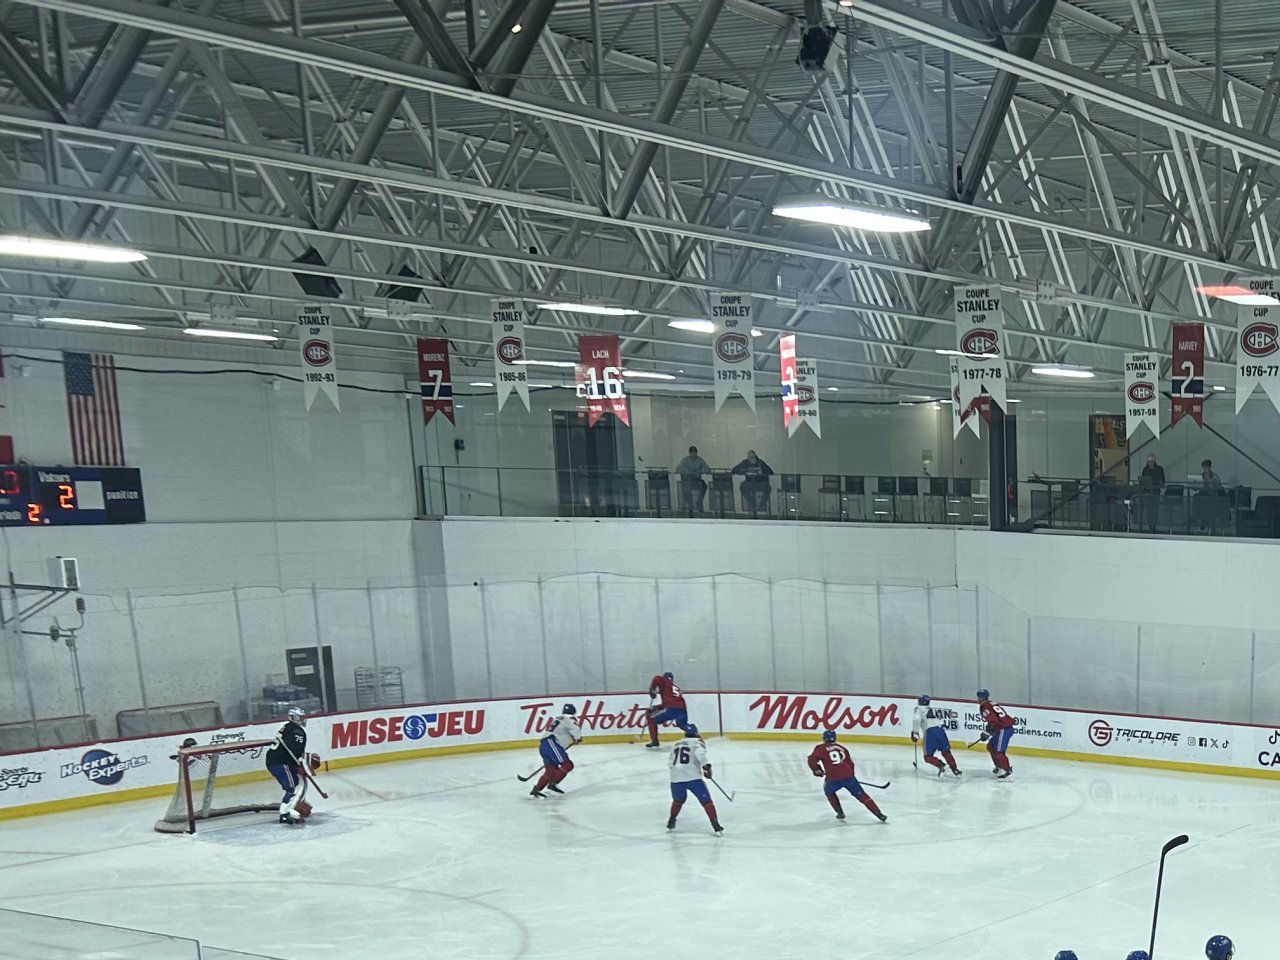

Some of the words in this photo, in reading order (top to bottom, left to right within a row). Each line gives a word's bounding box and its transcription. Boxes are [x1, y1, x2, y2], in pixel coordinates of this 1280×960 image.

[1250, 280, 1274, 290] COUPE
[966, 289, 990, 298] COUPE
[499, 301, 515, 309] COUPE
[720, 296, 742, 304] COUPE
[304, 306, 322, 314] COUPE
[957, 299, 1000, 312] STANLEY
[493, 311, 523, 322] STANLEY
[712, 306, 750, 317] STANLEY
[1254, 307, 1268, 317] CUP
[298, 315, 330, 326] STANLEY
[971, 314, 986, 323] CUP
[504, 324, 514, 332] CUP
[1178, 341, 1198, 351] HARVEY
[592, 350, 609, 359] LACH
[1126, 362, 1156, 371] STANLEY
[1240, 365, 1279, 377] 1976-77
[499, 372, 526, 382] 1985-86
[717, 370, 752, 380] 1978-79
[962, 368, 1002, 380] 1977-78
[586, 366, 621, 400] 16
[1180, 360, 1195, 399] 2
[428, 369, 443, 401] 7
[1128, 408, 1157, 416] 1957-58
[59, 484, 74, 509] 2
[27, 503, 41, 522] 2
[749, 695, 897, 731] Molson
[294, 734, 304, 744] 75
[1115, 728, 1181, 741] TRICOLORE
[60, 753, 119, 778] HOCKEY
[88, 755, 148, 781] Experts
